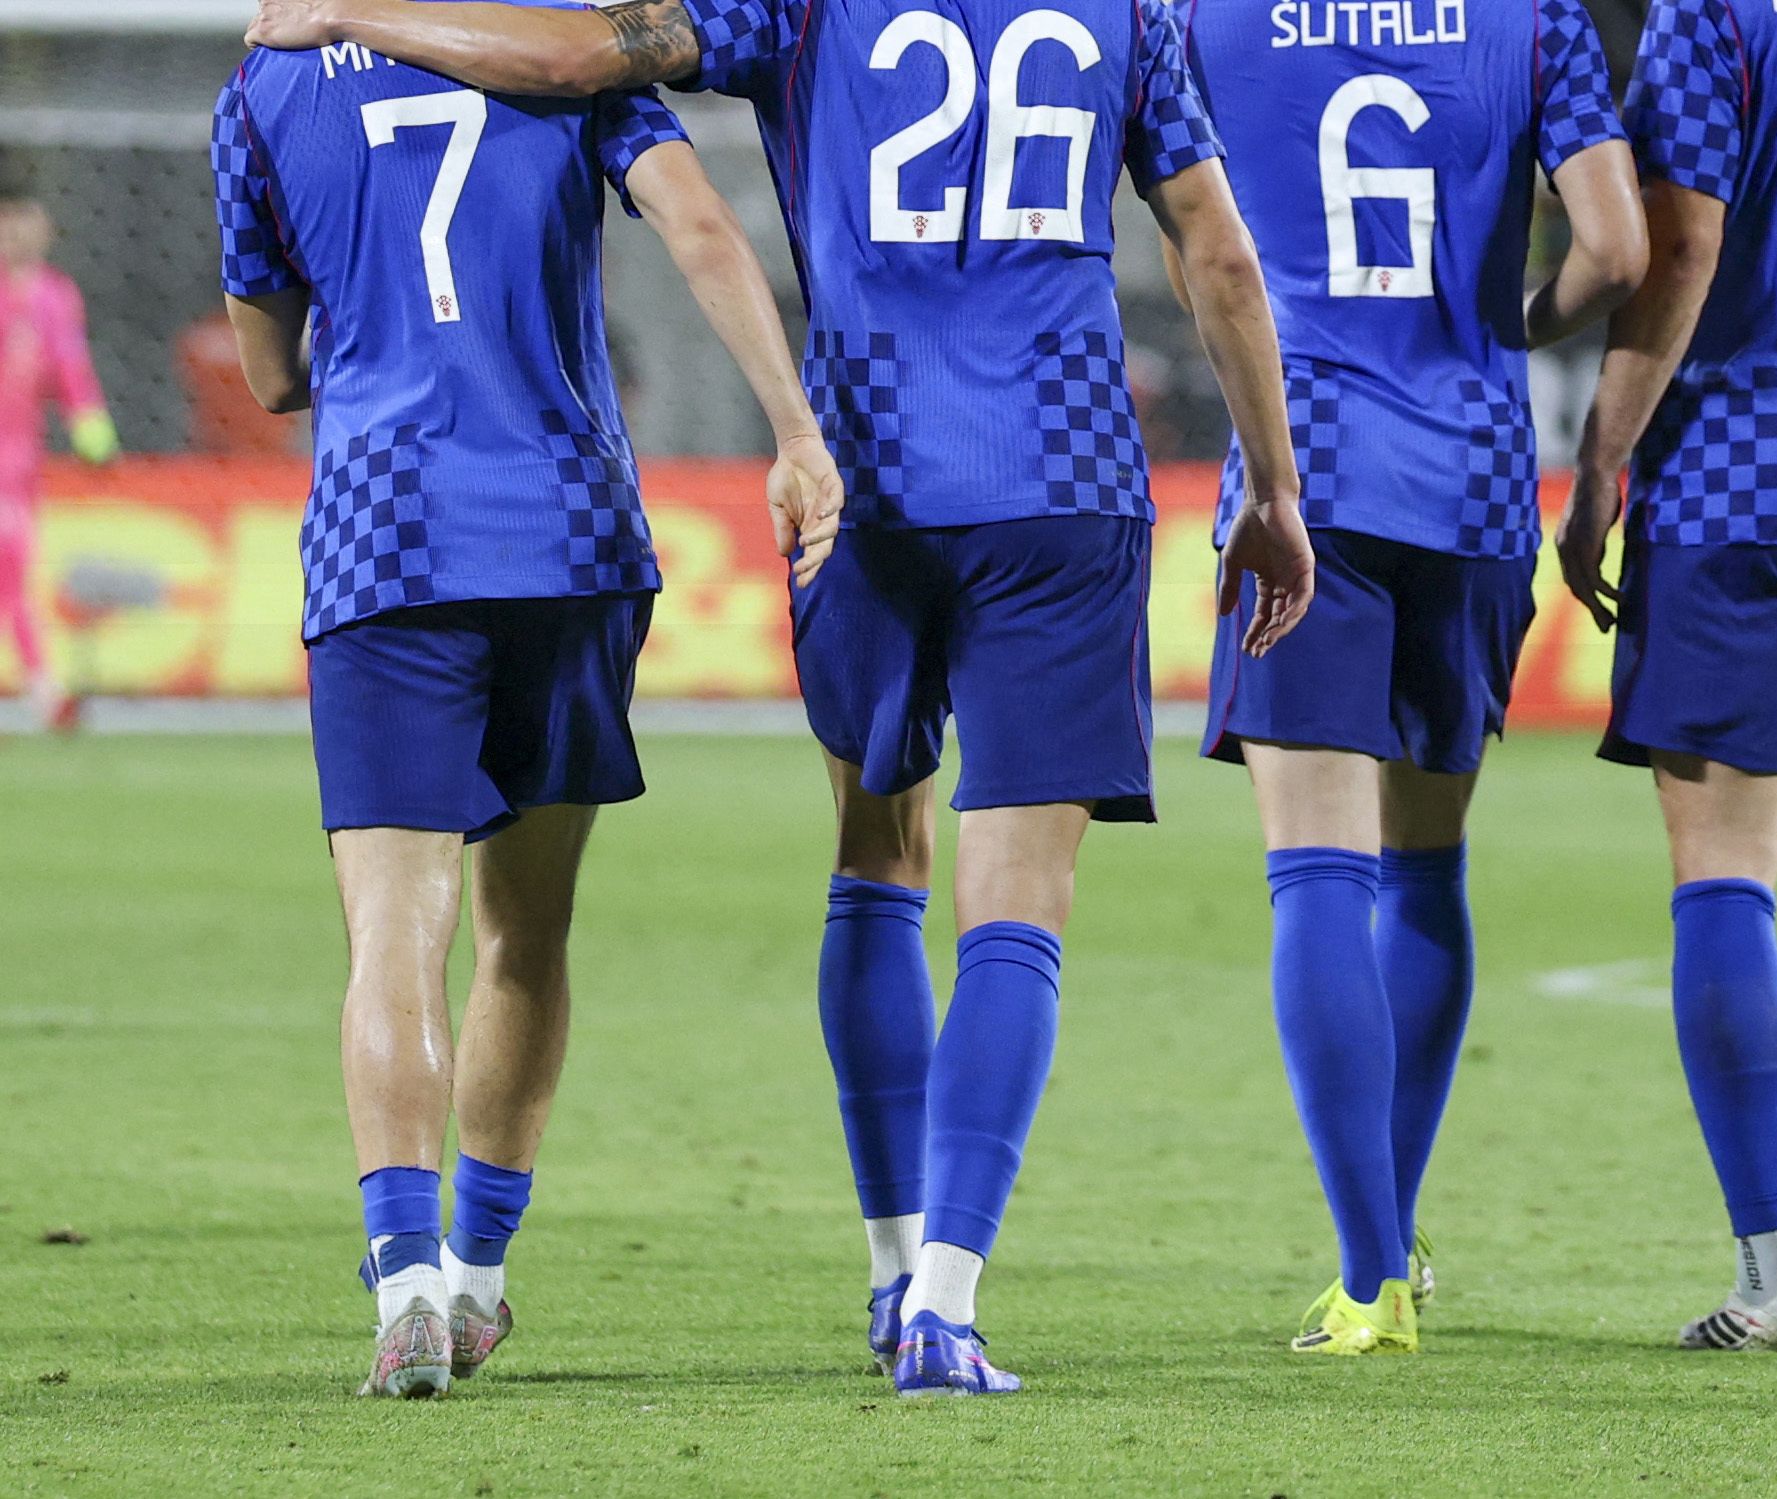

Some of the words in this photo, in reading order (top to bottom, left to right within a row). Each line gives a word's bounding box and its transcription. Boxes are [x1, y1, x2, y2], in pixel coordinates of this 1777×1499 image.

[360, 87, 488, 324] 7
[868, 9, 1102, 244] 26
[1318, 73, 1436, 299] 6
